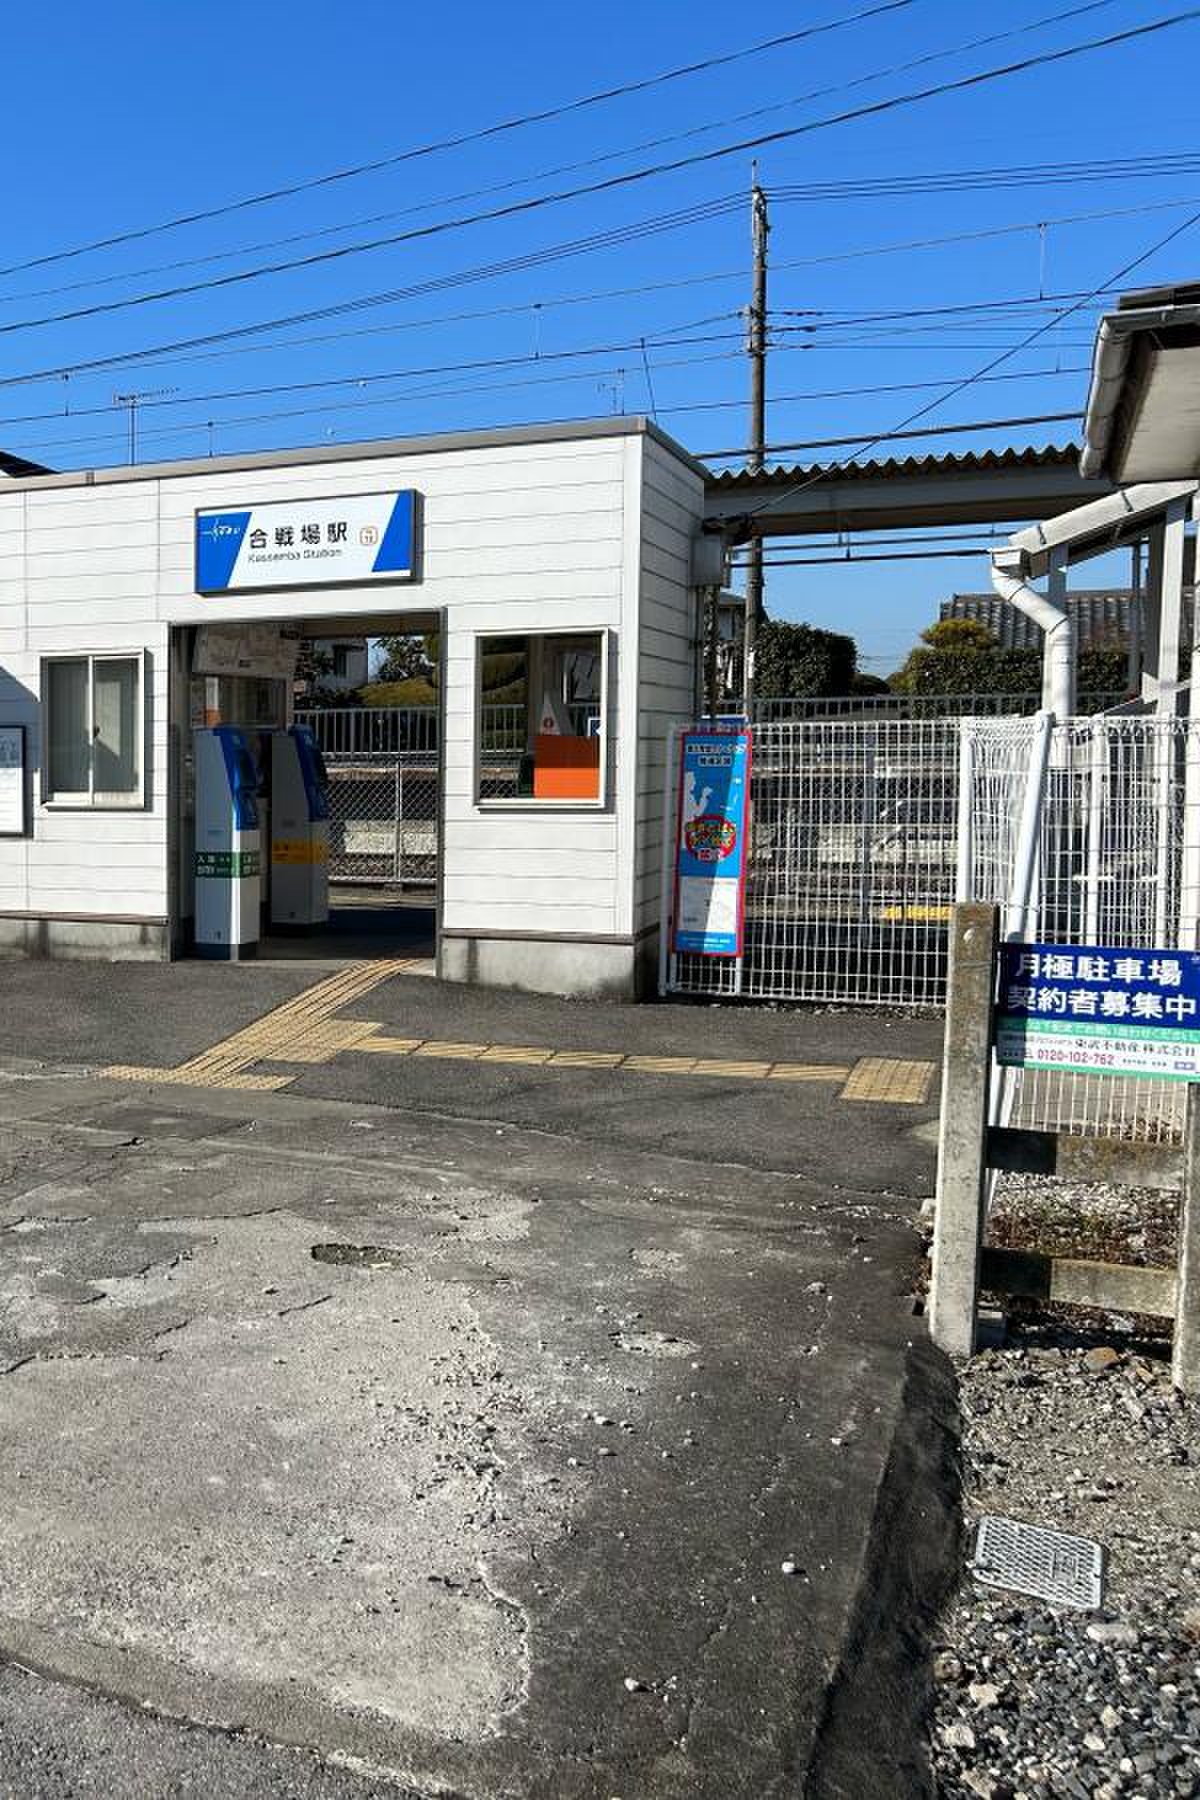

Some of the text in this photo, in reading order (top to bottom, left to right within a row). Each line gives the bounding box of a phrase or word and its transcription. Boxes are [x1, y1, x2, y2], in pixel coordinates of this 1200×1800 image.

[249, 522, 348, 549] 合戦場駅
[1016, 953, 1183, 987] 月極駐車場
[1007, 986, 1196, 1021] 契約者募集中
[1036, 1048, 1115, 1066] 0120-102-762
